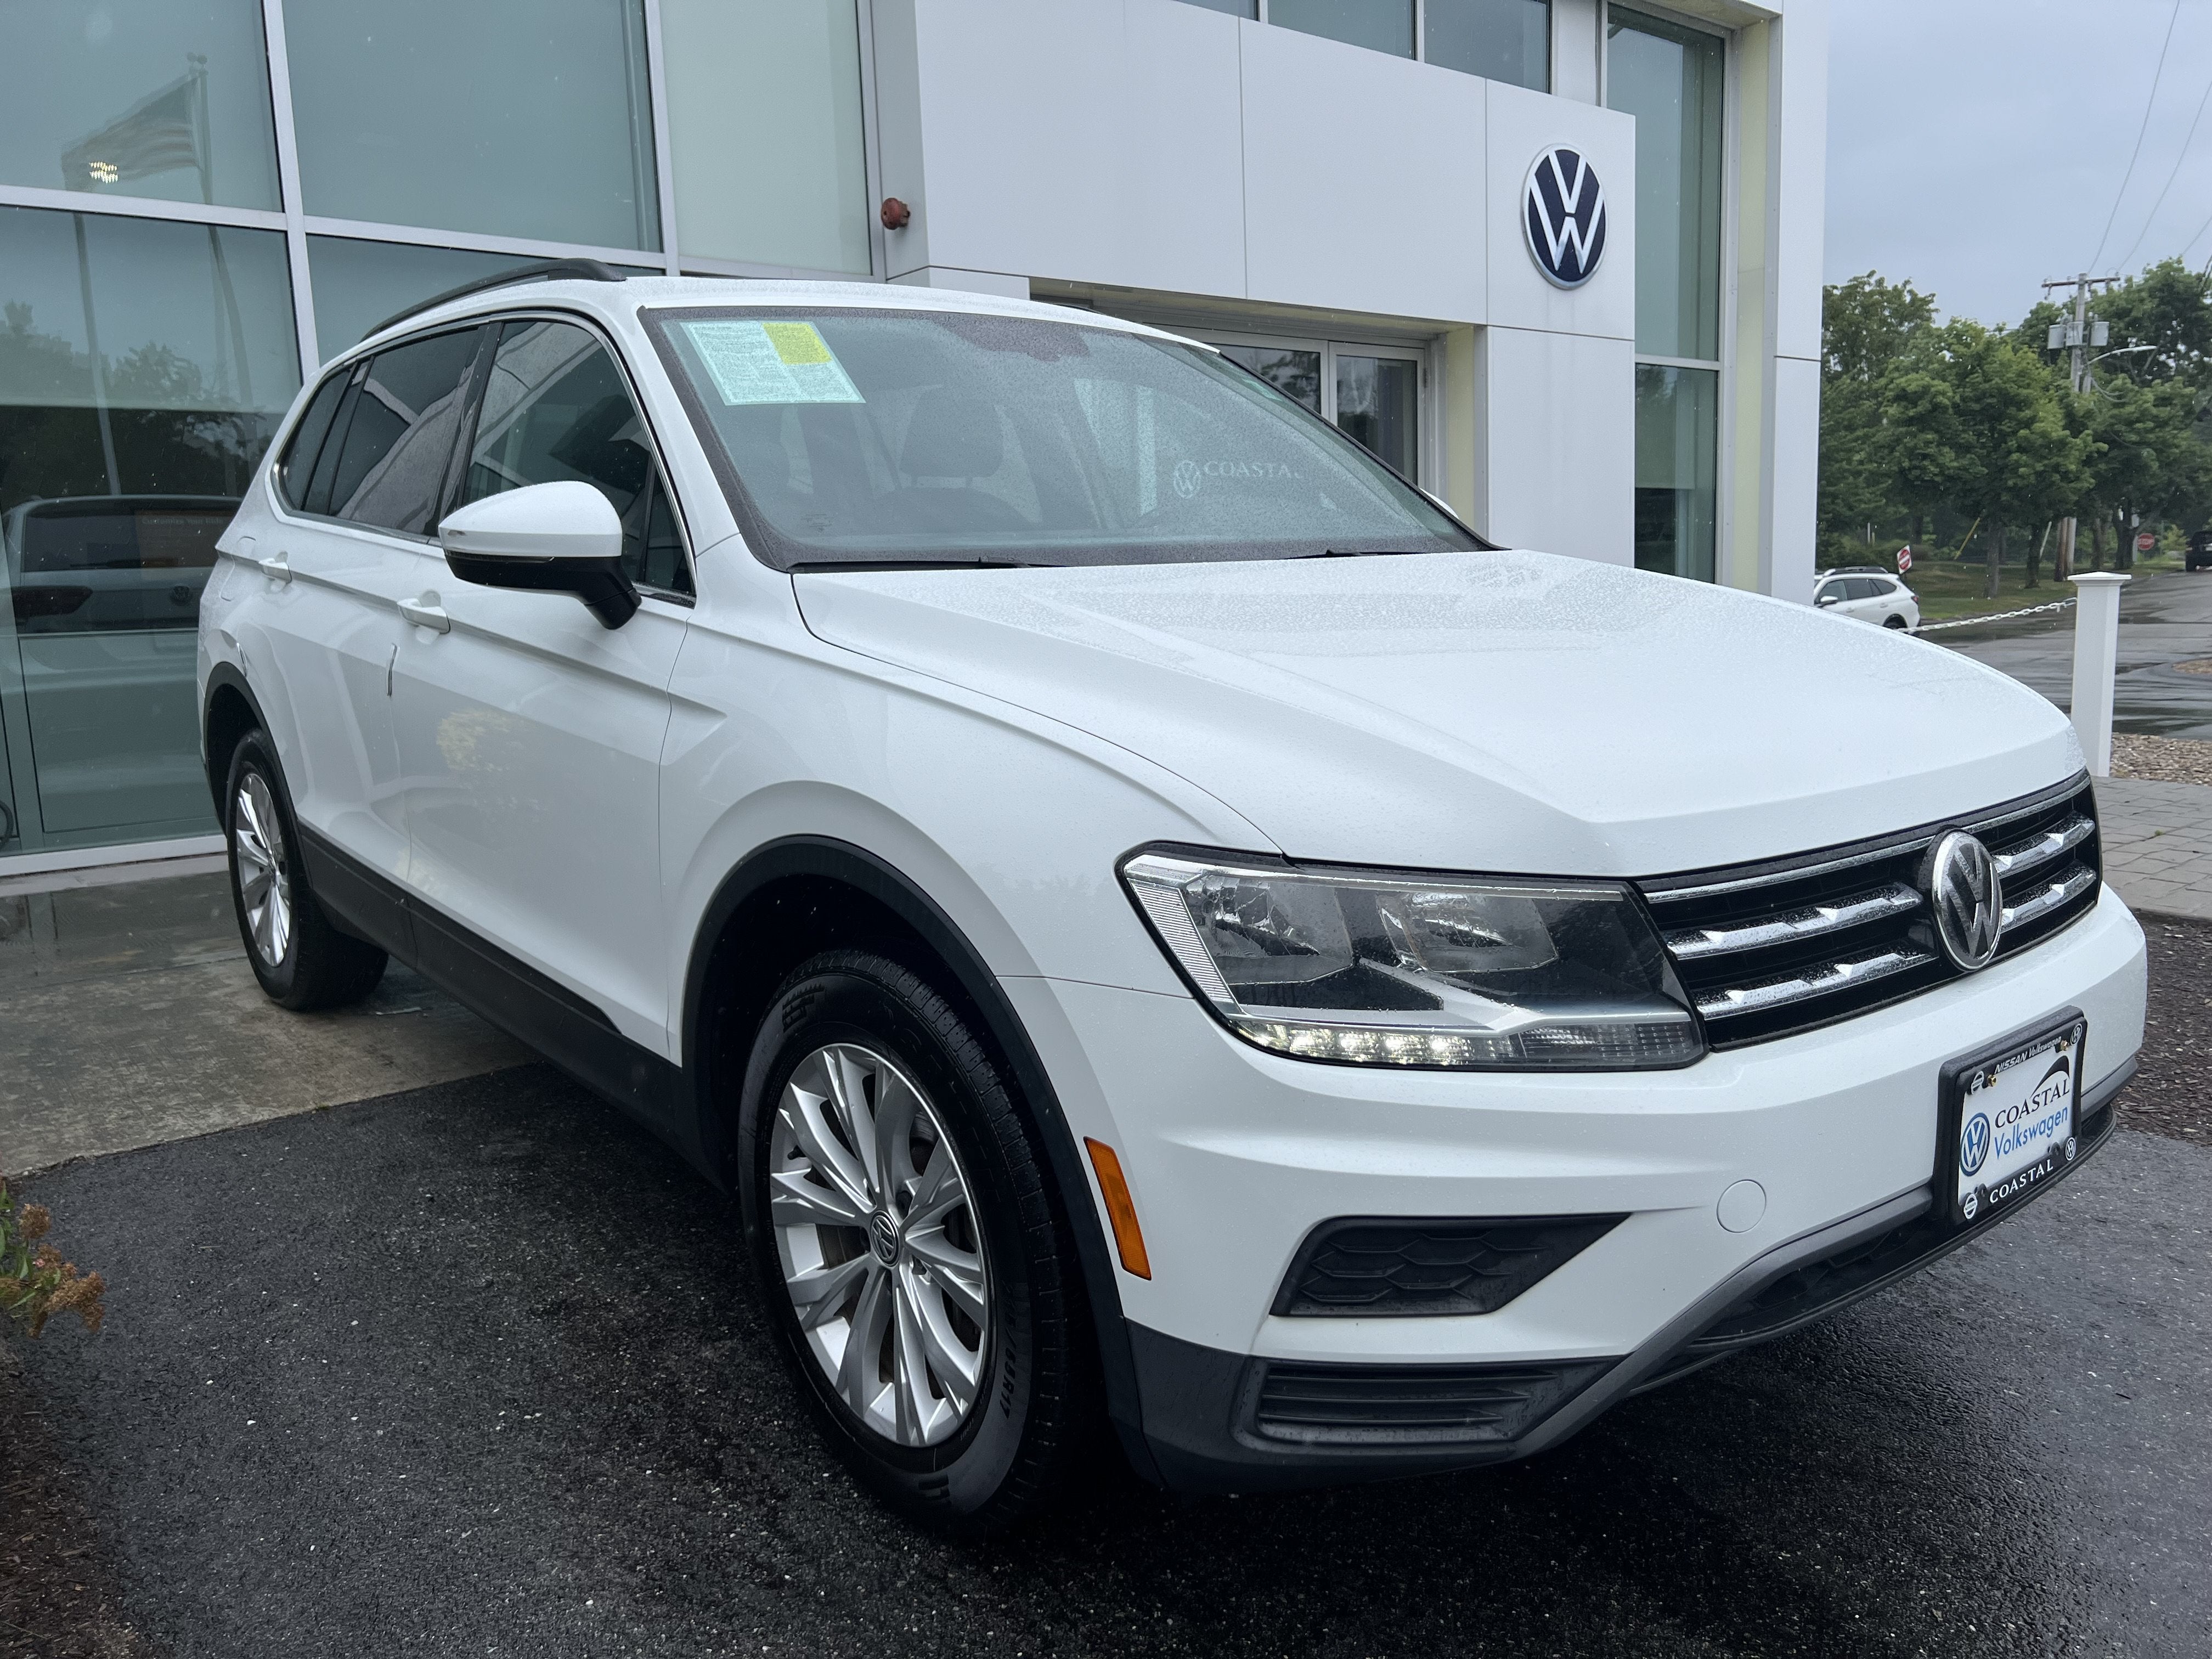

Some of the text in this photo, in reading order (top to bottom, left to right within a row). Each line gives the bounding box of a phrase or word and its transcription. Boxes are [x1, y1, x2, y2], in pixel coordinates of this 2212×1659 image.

[1994, 1036, 2062, 1074] NISSAN Volkswagen
[1994, 1077, 2070, 1128] COASTAL
[1994, 1105, 2068, 1160] Volkswagen
[1989, 1159, 2054, 1204] COASTAL
